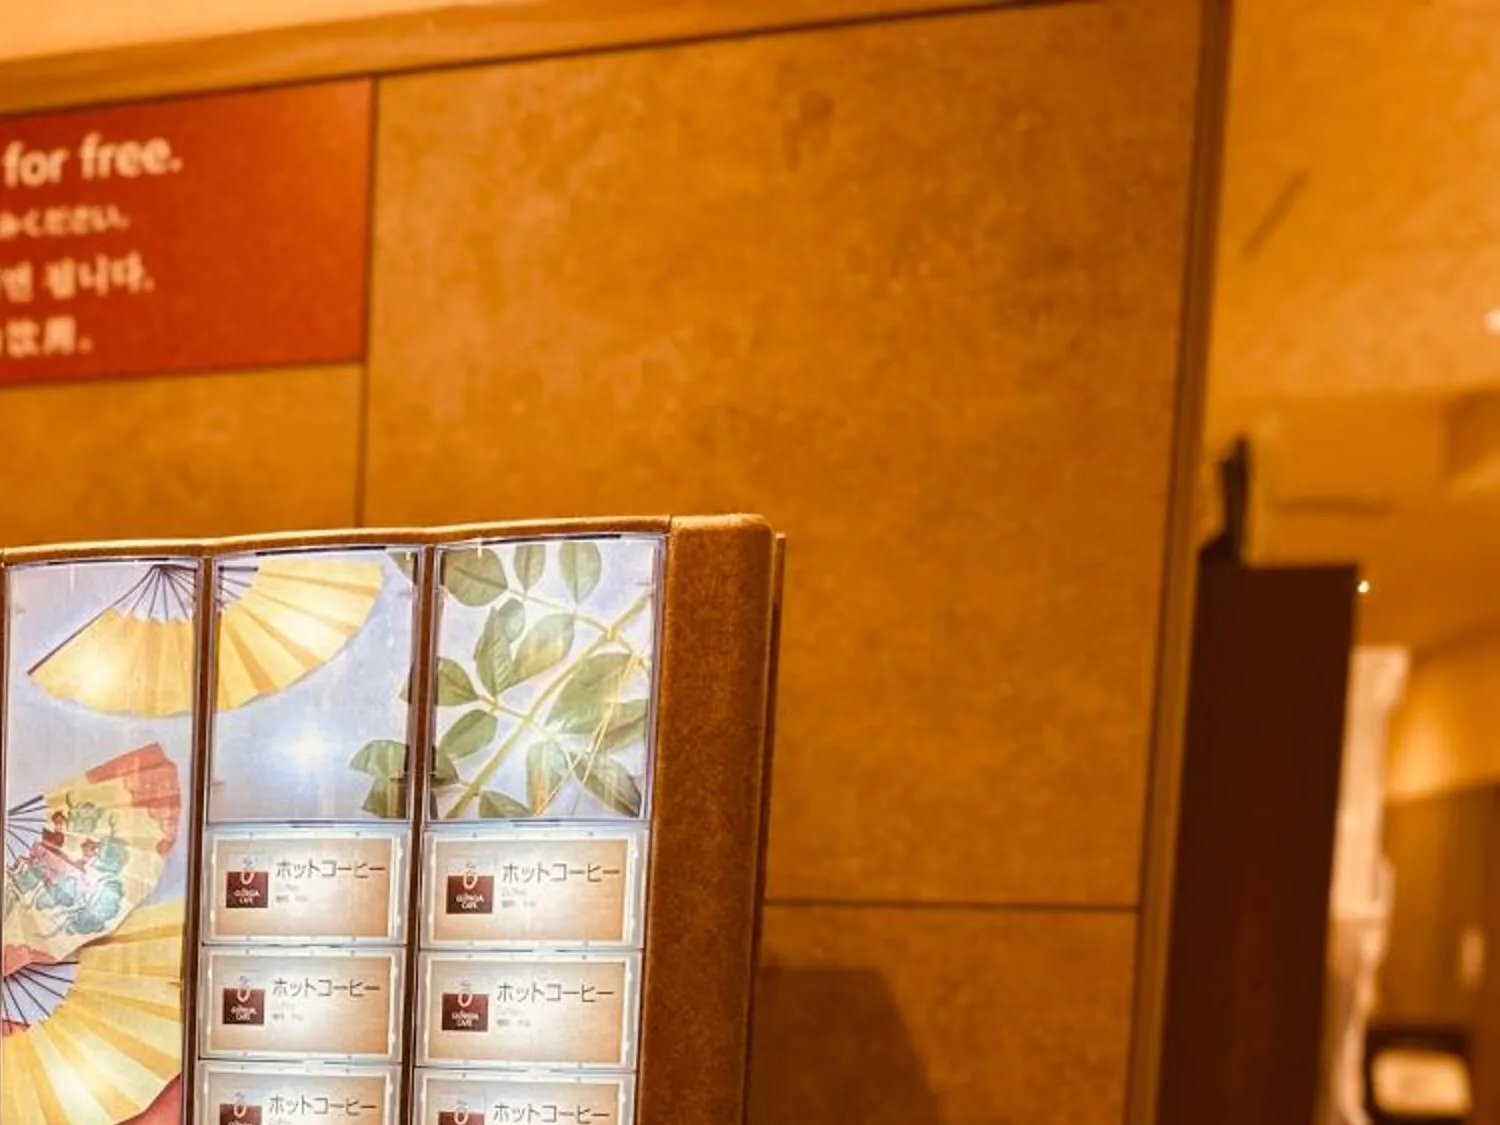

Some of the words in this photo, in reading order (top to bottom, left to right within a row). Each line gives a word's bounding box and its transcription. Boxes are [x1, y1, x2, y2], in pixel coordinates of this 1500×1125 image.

[3, 139, 69, 189] for
[79, 131, 183, 180] free.
[275, 858, 386, 880] ホットコーヒー
[502, 862, 621, 884] ホットコーヒー
[272, 977, 381, 998] ホットコーヒー
[496, 982, 615, 1004] ホットコーヒー
[268, 1096, 377, 1117] ホットコーヒー
[492, 1103, 611, 1125] ホットコーヒー
